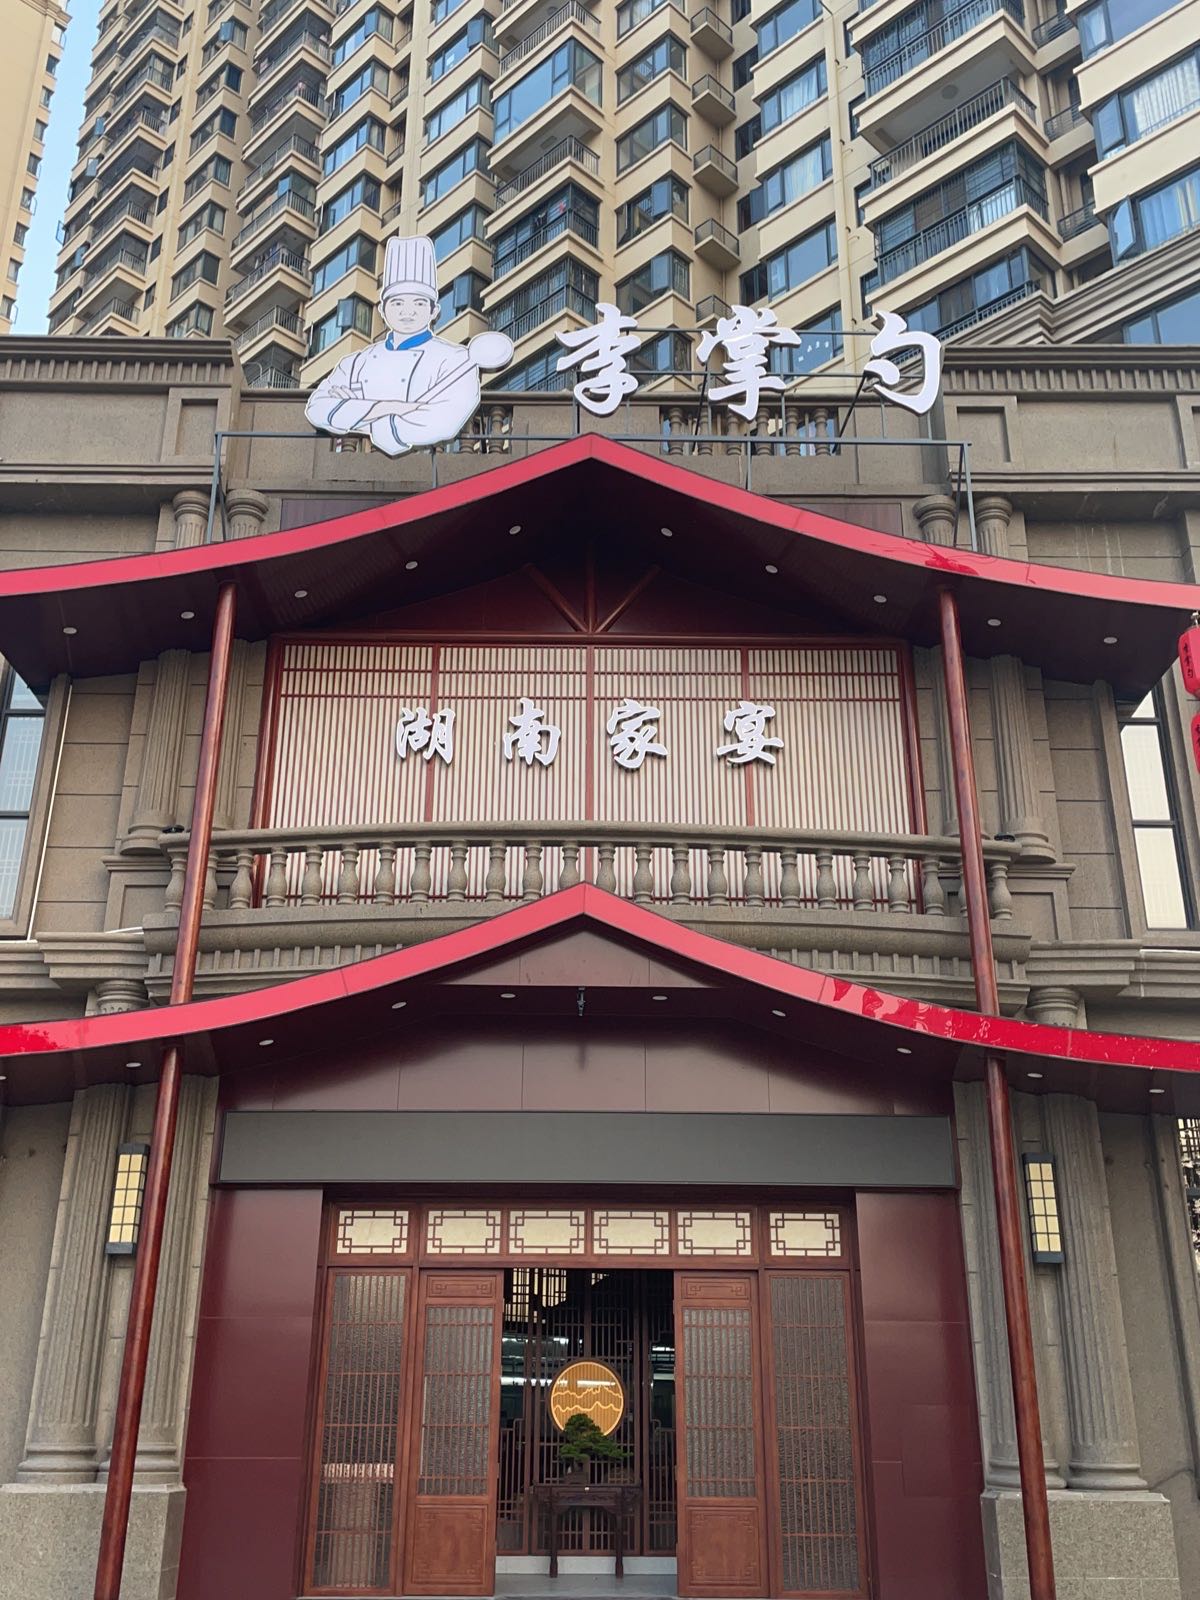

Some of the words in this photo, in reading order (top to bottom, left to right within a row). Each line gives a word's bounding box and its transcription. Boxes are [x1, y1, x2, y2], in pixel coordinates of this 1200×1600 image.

[556, 303, 942, 420] 李掌勺
[395, 698, 785, 770] 湖南家宴
